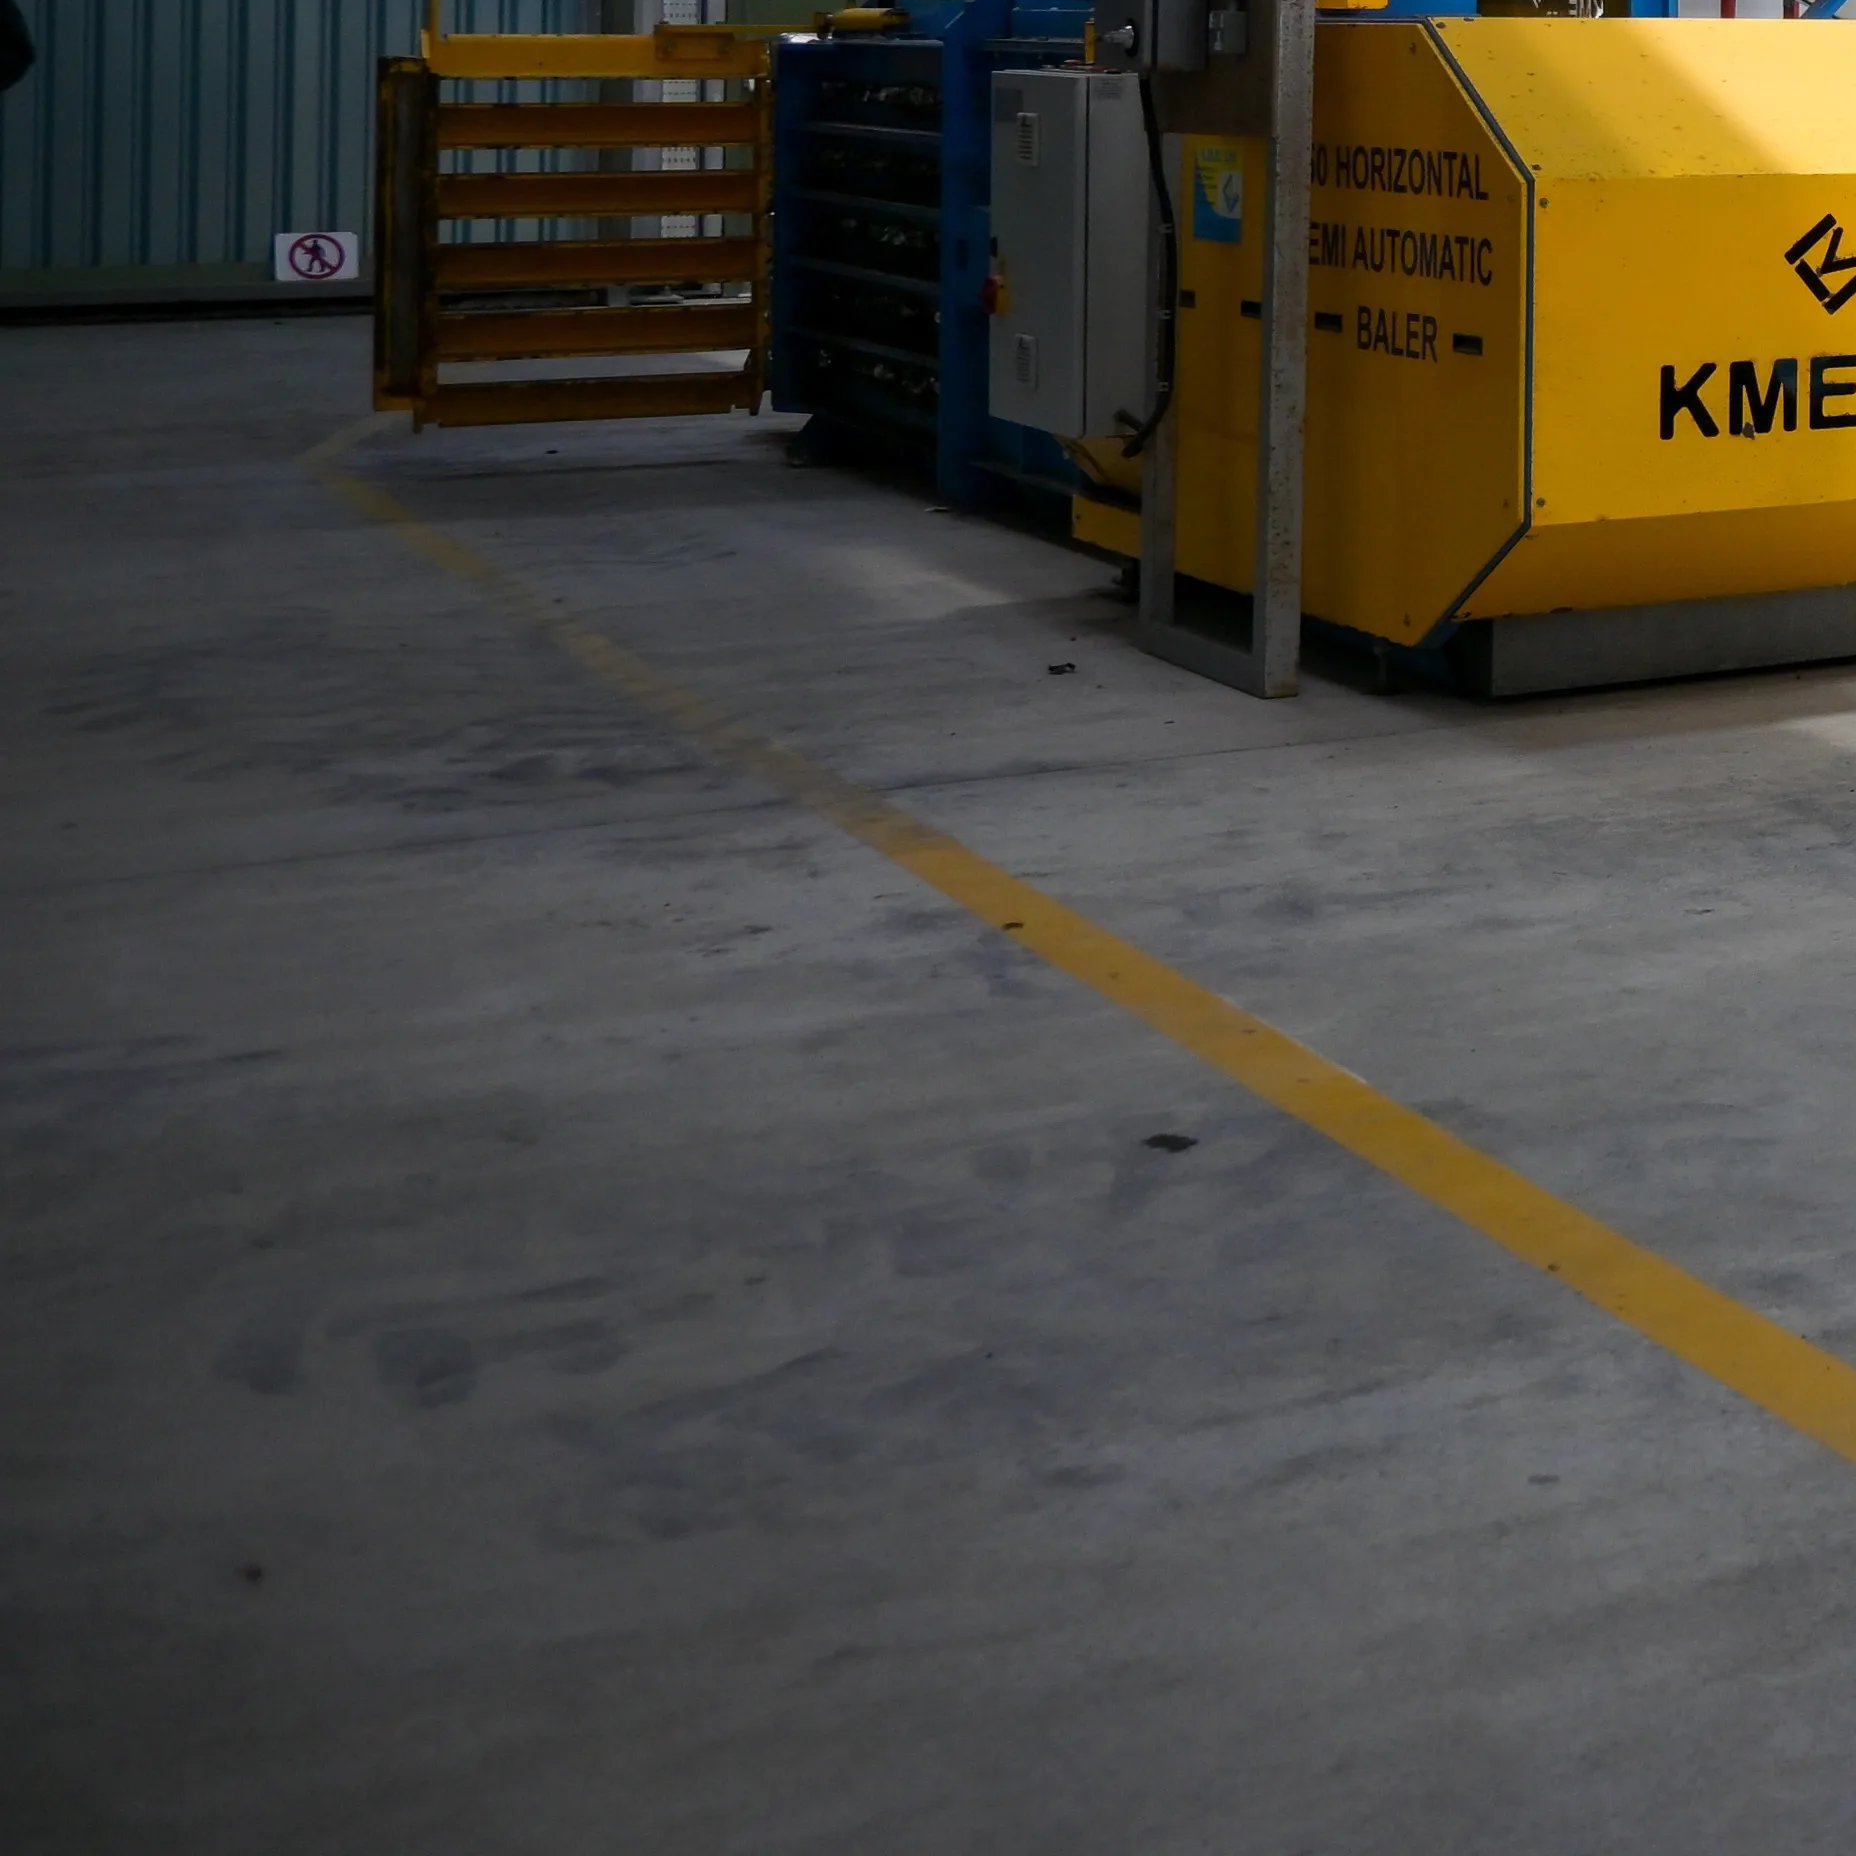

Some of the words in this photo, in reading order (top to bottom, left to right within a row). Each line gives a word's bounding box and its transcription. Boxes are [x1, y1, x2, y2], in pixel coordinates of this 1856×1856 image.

[1335, 145, 1489, 200] HORIZONTAL
[1308, 222, 1346, 268] EMI
[1352, 226, 1493, 286] AUTOMATIC
[1357, 305, 1438, 363] BALER
